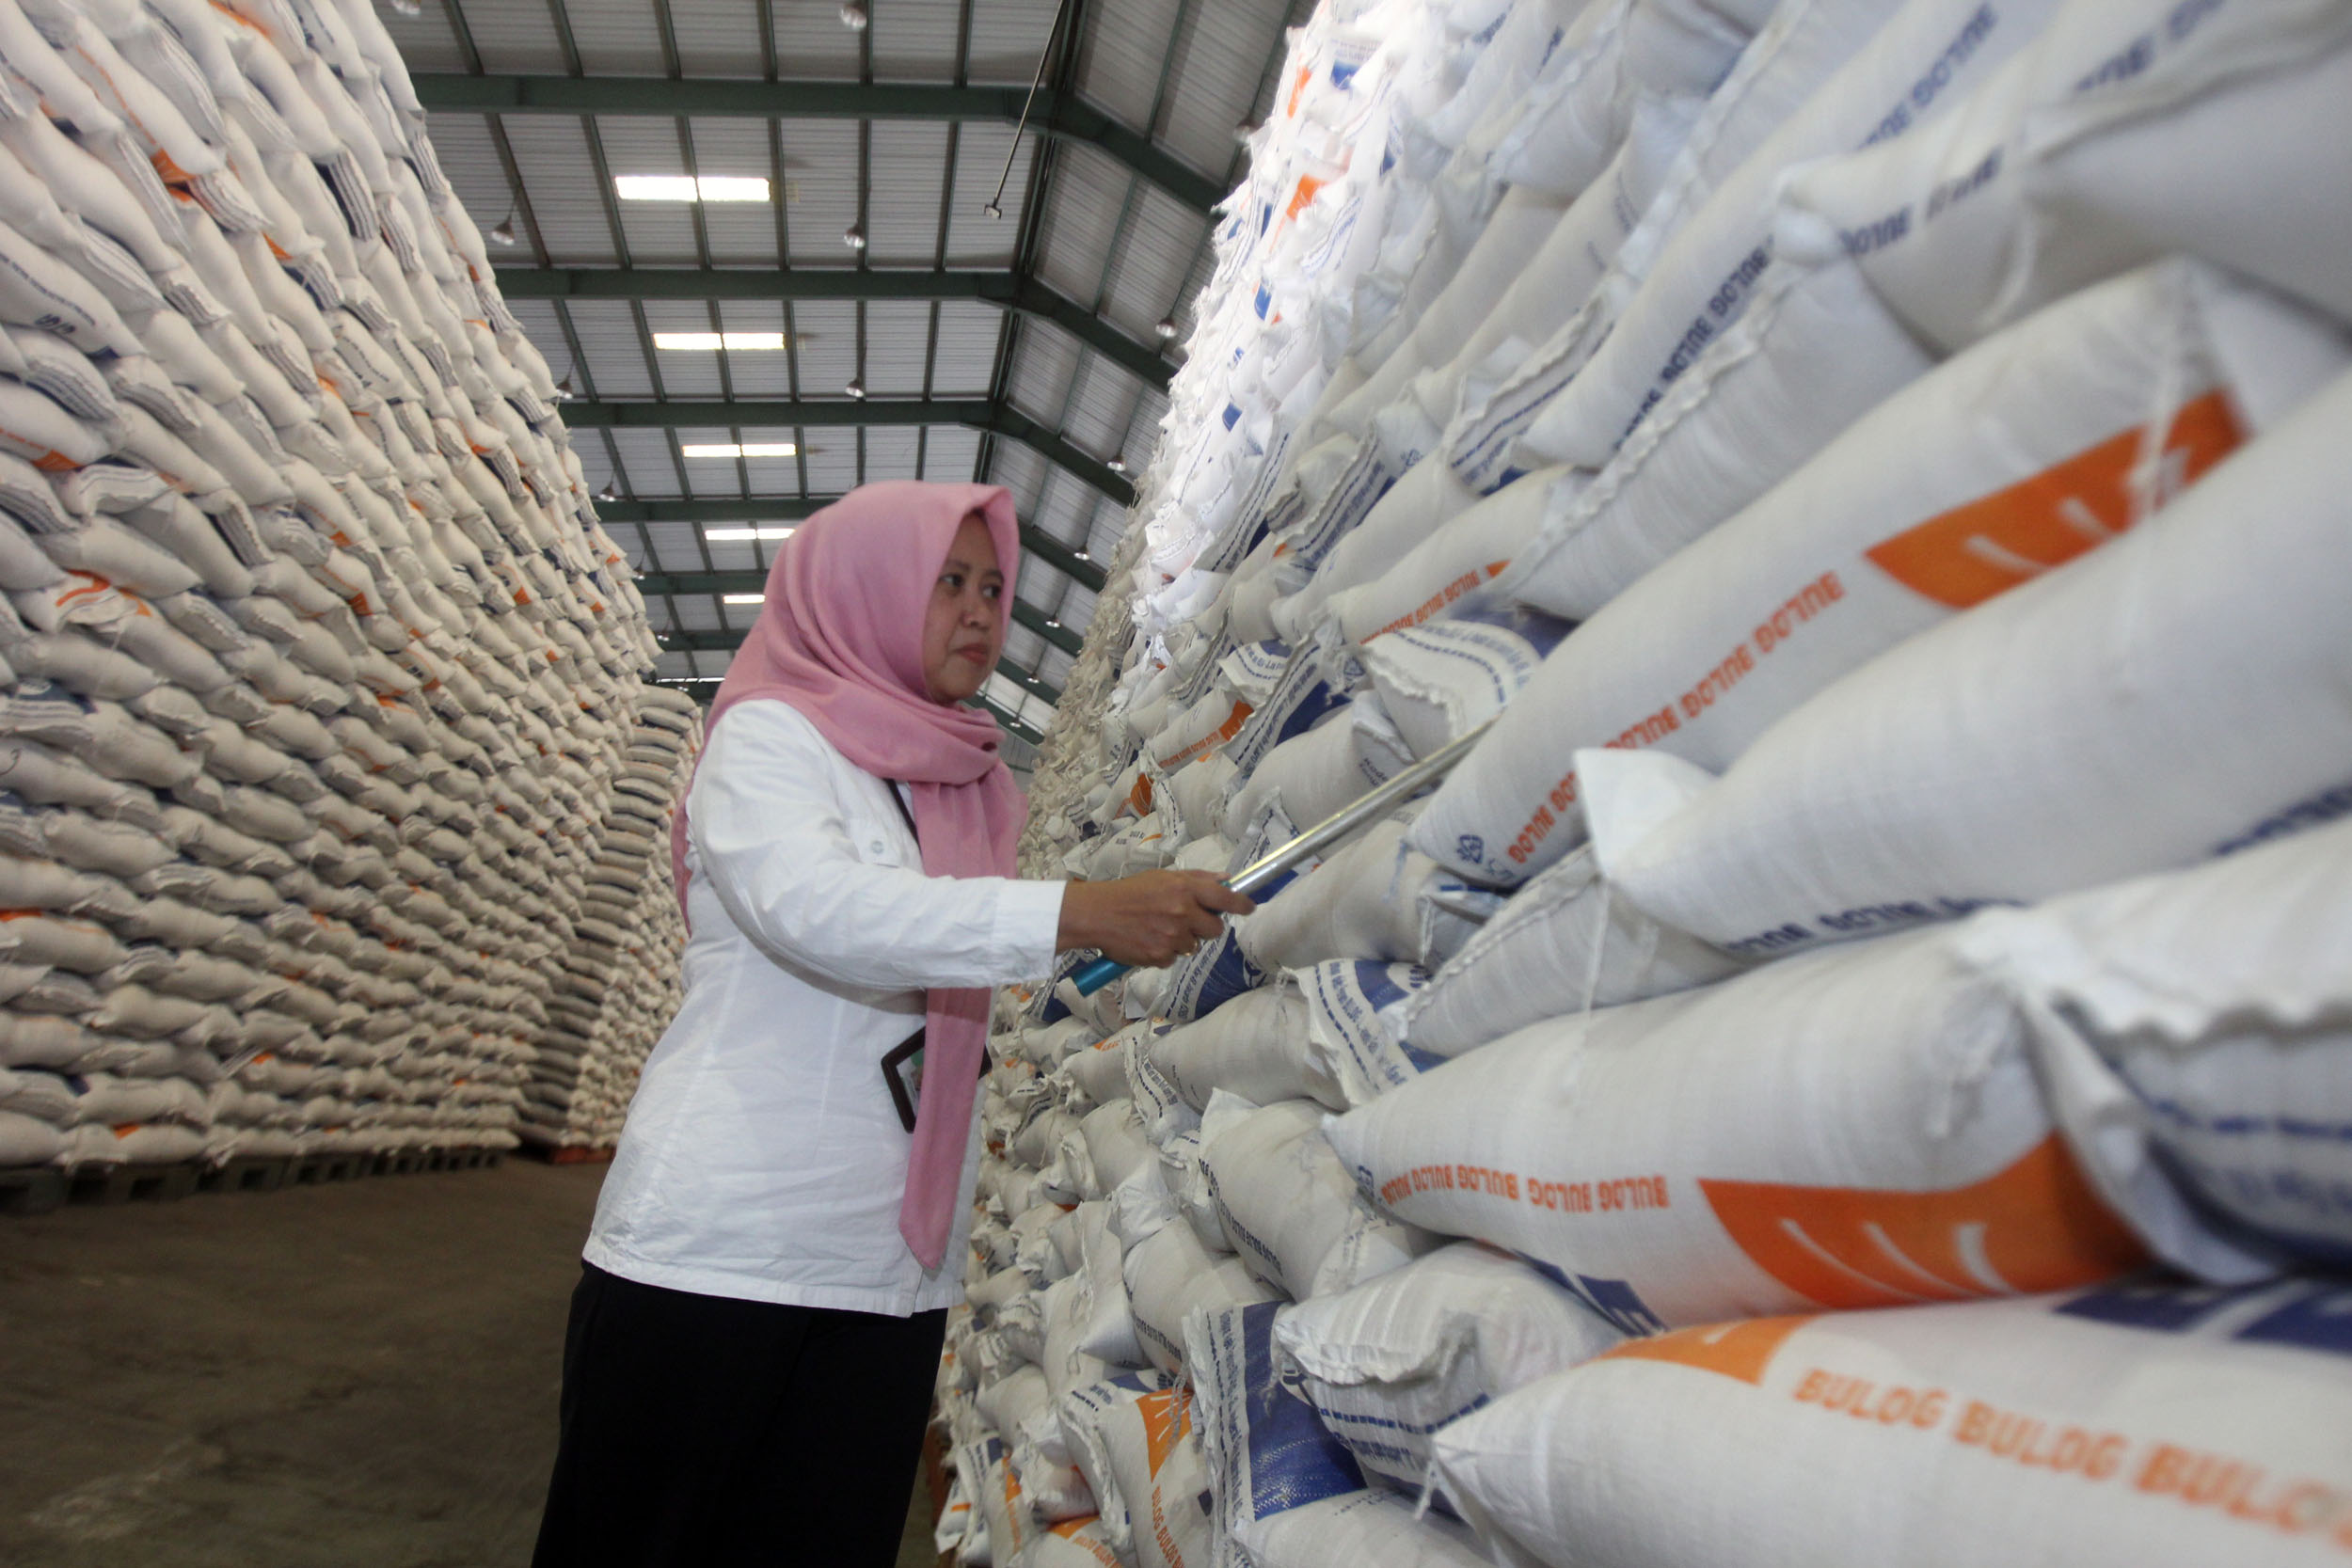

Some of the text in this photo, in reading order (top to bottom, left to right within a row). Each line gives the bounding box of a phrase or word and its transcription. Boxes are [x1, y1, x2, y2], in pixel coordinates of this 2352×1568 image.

[1753, 570, 1847, 655] BULOG
[1680, 642, 1755, 720] BULOG
[1604, 703, 1681, 750] BULO
[1411, 1163, 1455, 1192] BULOG
[1456, 1163, 1521, 1200] BULOG
[1526, 1177, 1595, 1213] BULOG
[1597, 1173, 1671, 1212] BULOG
[1792, 1367, 2352, 1558] BULOG BULOG BULO
